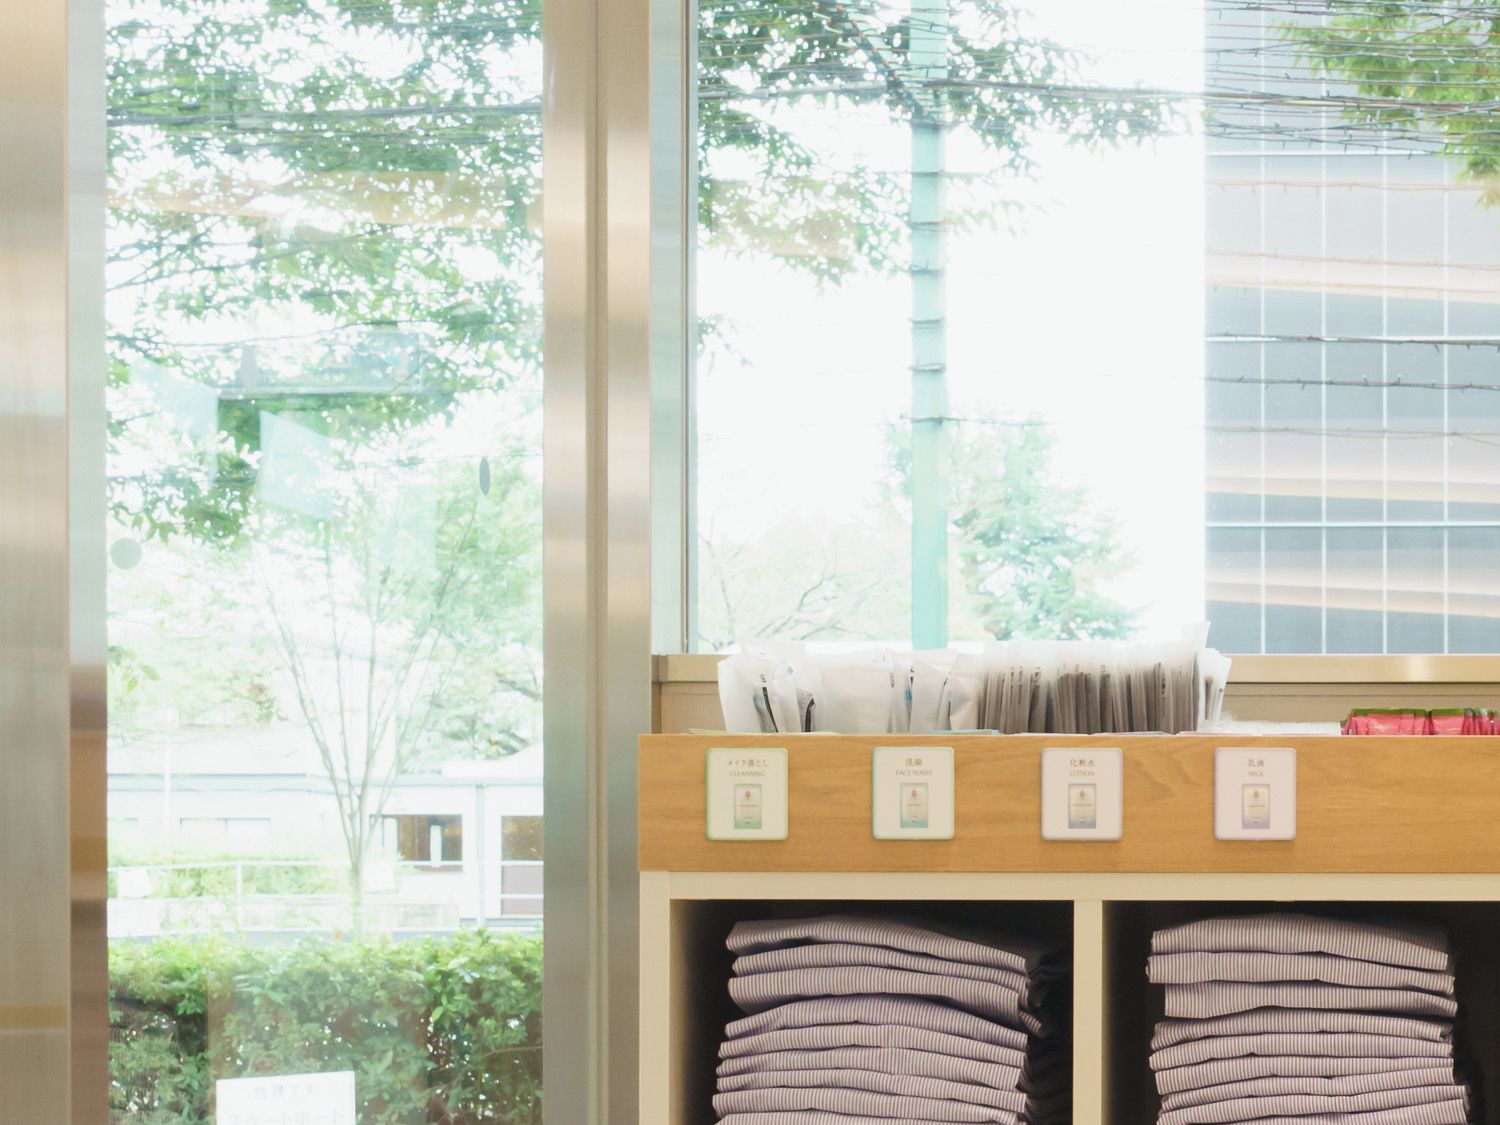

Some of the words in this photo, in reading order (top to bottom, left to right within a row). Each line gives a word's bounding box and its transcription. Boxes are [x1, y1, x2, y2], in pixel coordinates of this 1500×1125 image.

[726, 759, 769, 768] メイク落とし
[905, 758, 923, 768] 洗顔
[1070, 759, 1095, 768] 化粧水
[1248, 759, 1265, 768] 乳液
[895, 769, 911, 777] FACE
[912, 769, 933, 777] WASH
